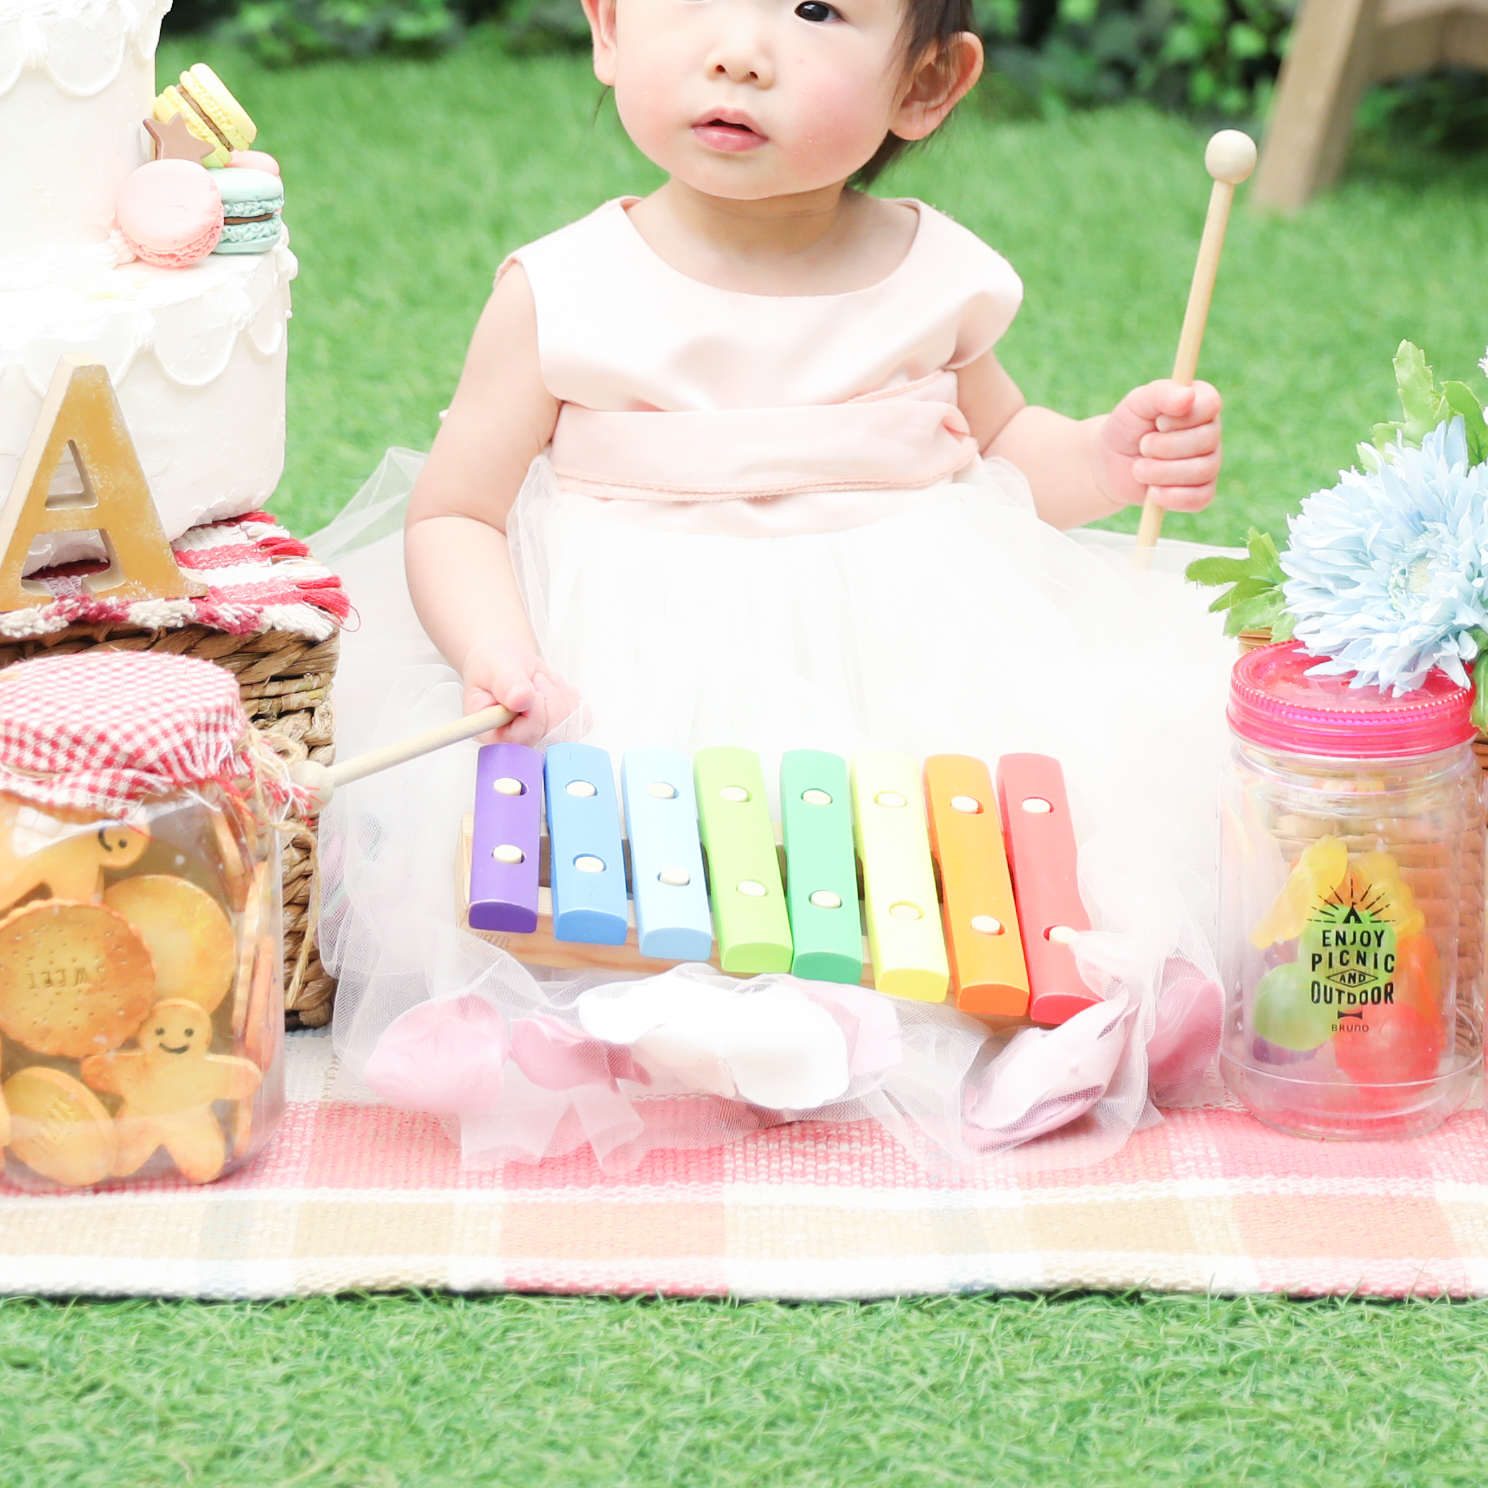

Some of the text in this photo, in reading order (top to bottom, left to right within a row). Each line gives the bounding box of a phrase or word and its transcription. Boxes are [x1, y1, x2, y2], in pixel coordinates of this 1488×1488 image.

[1321, 929, 1386, 948] ENJOY
[1311, 949, 1395, 974] PICNIC
[1339, 972, 1367, 985] AND
[1311, 980, 1395, 1006] OUTDOOR
